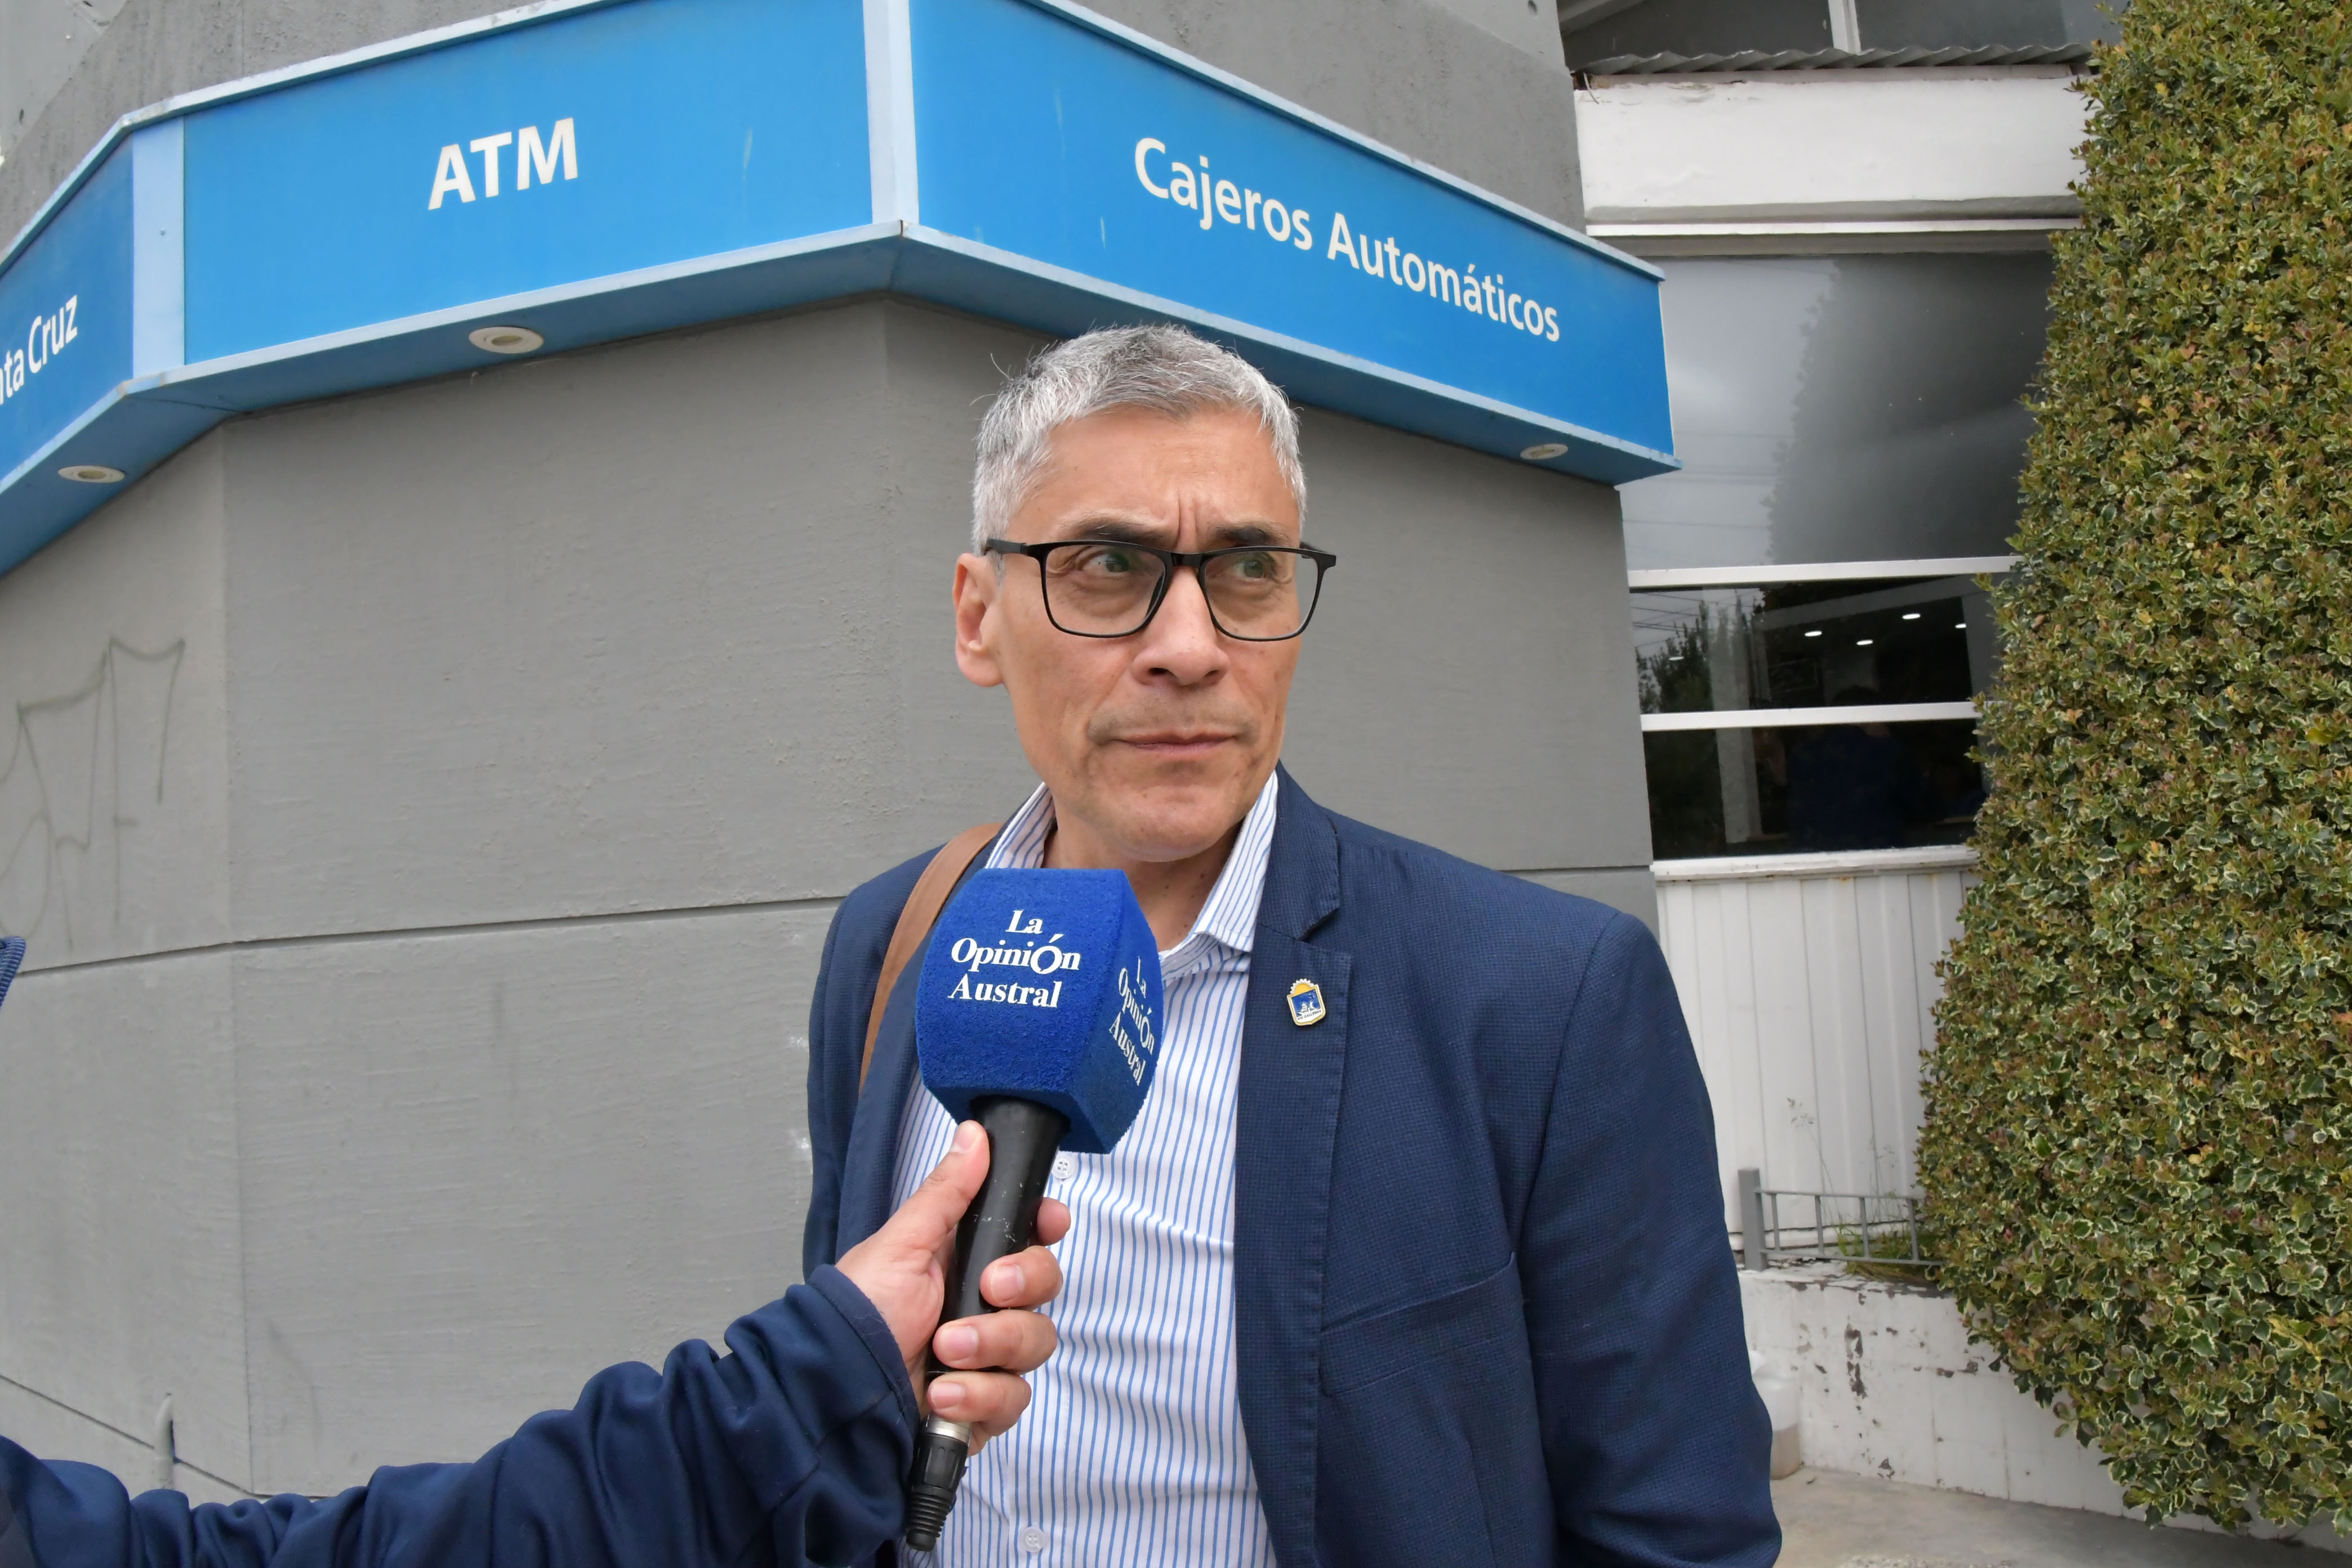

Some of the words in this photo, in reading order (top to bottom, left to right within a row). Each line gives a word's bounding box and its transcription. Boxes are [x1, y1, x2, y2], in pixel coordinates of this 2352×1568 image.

[428, 117, 578, 210] ATM
[1134, 137, 1313, 251] Cajeros
[1328, 212, 1560, 342] Automáticos
[28, 294, 78, 373] Cruz
[1006, 909, 1043, 934] La
[947, 973, 1063, 1008] Austral
[1137, 956, 1147, 999] La
[1109, 1011, 1146, 1086] Austral
